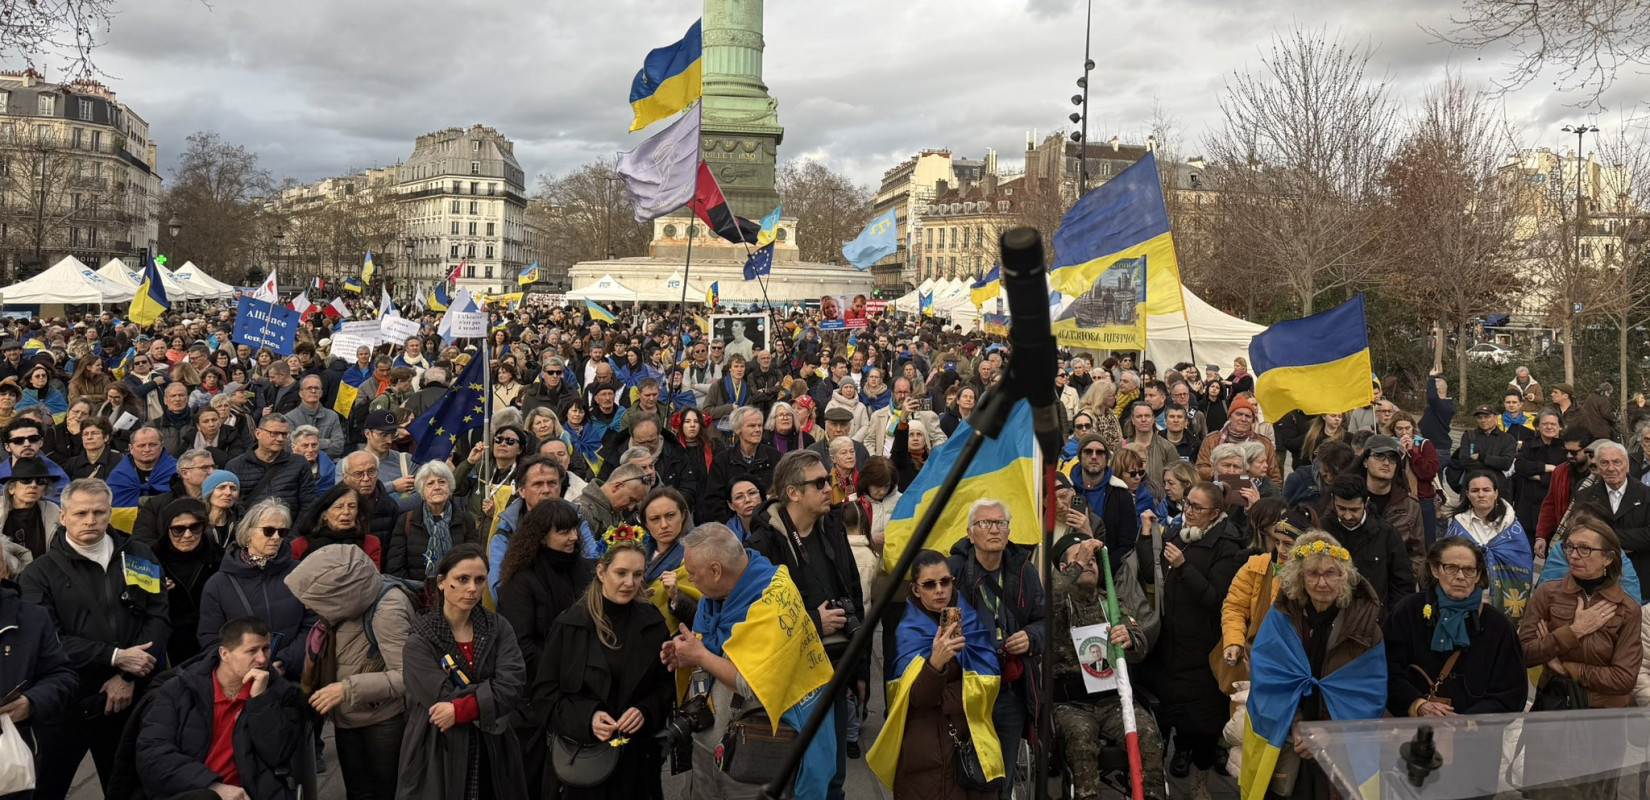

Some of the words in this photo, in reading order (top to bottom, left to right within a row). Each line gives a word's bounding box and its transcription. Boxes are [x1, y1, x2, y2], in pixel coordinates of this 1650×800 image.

[246, 309, 288, 328] Alliance
[259, 326, 276, 337] des
[243, 333, 280, 349] femmes
